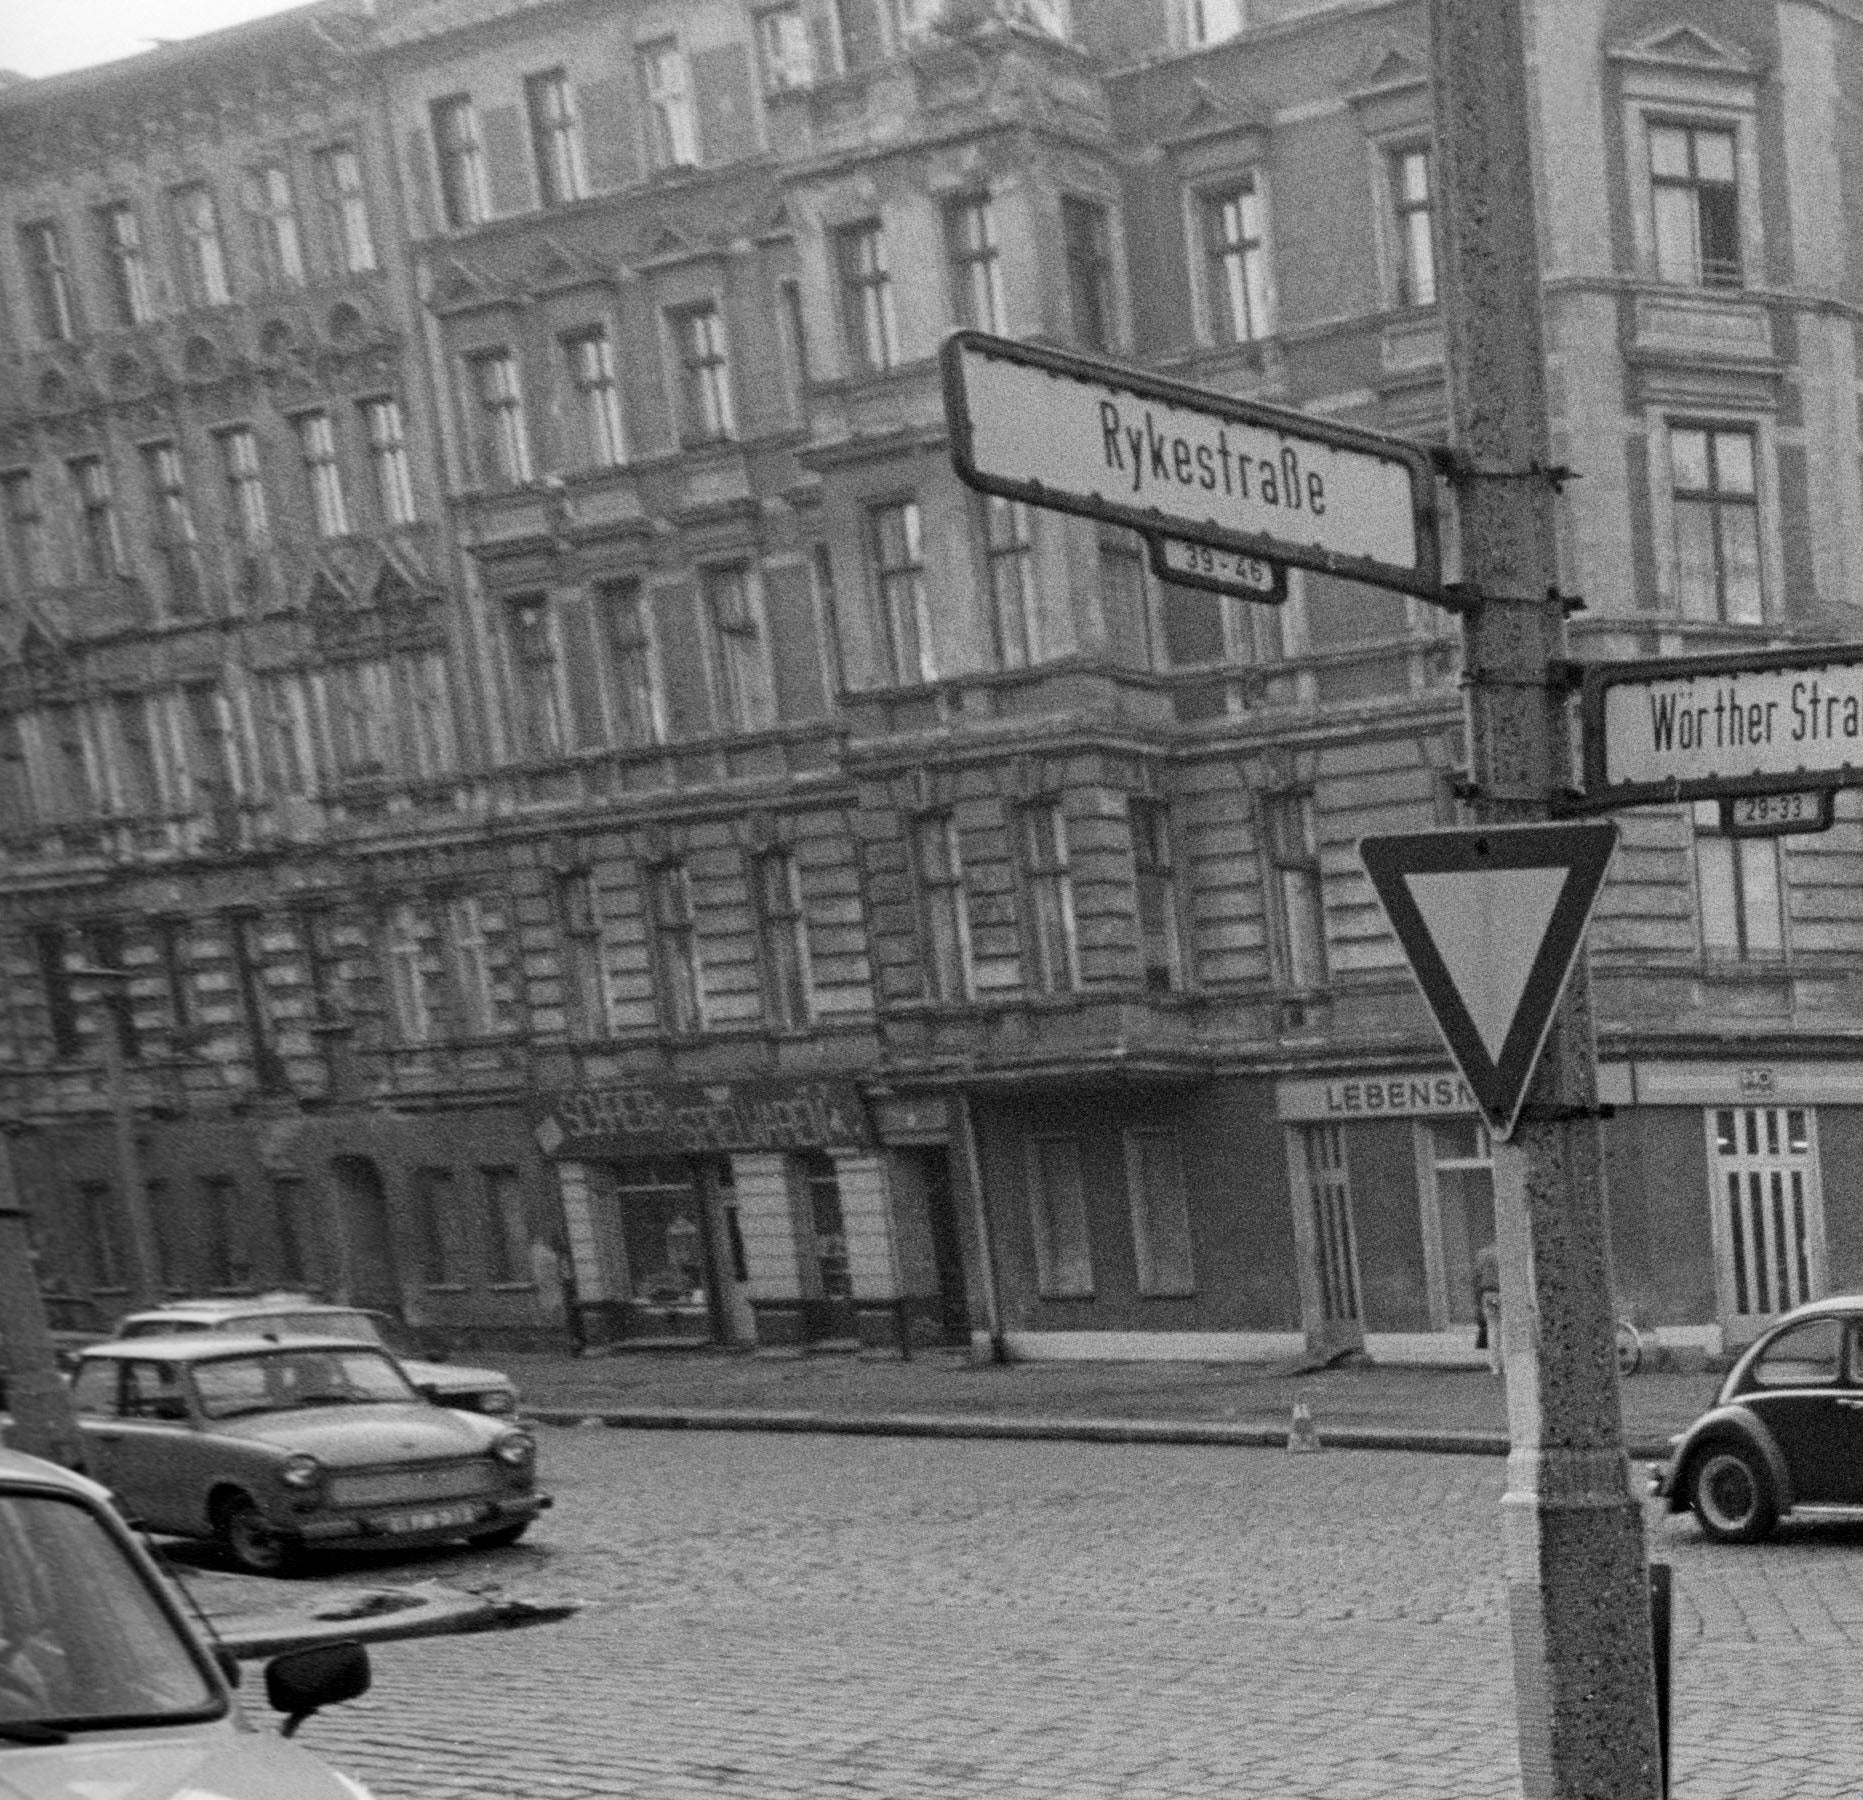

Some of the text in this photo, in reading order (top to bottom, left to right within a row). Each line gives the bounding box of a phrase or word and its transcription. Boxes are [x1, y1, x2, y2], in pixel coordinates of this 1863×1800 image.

[1100, 400, 1326, 515] Rykestraße
[1650, 687, 1779, 751] Wörther
[1745, 794, 1802, 821] 29-33
